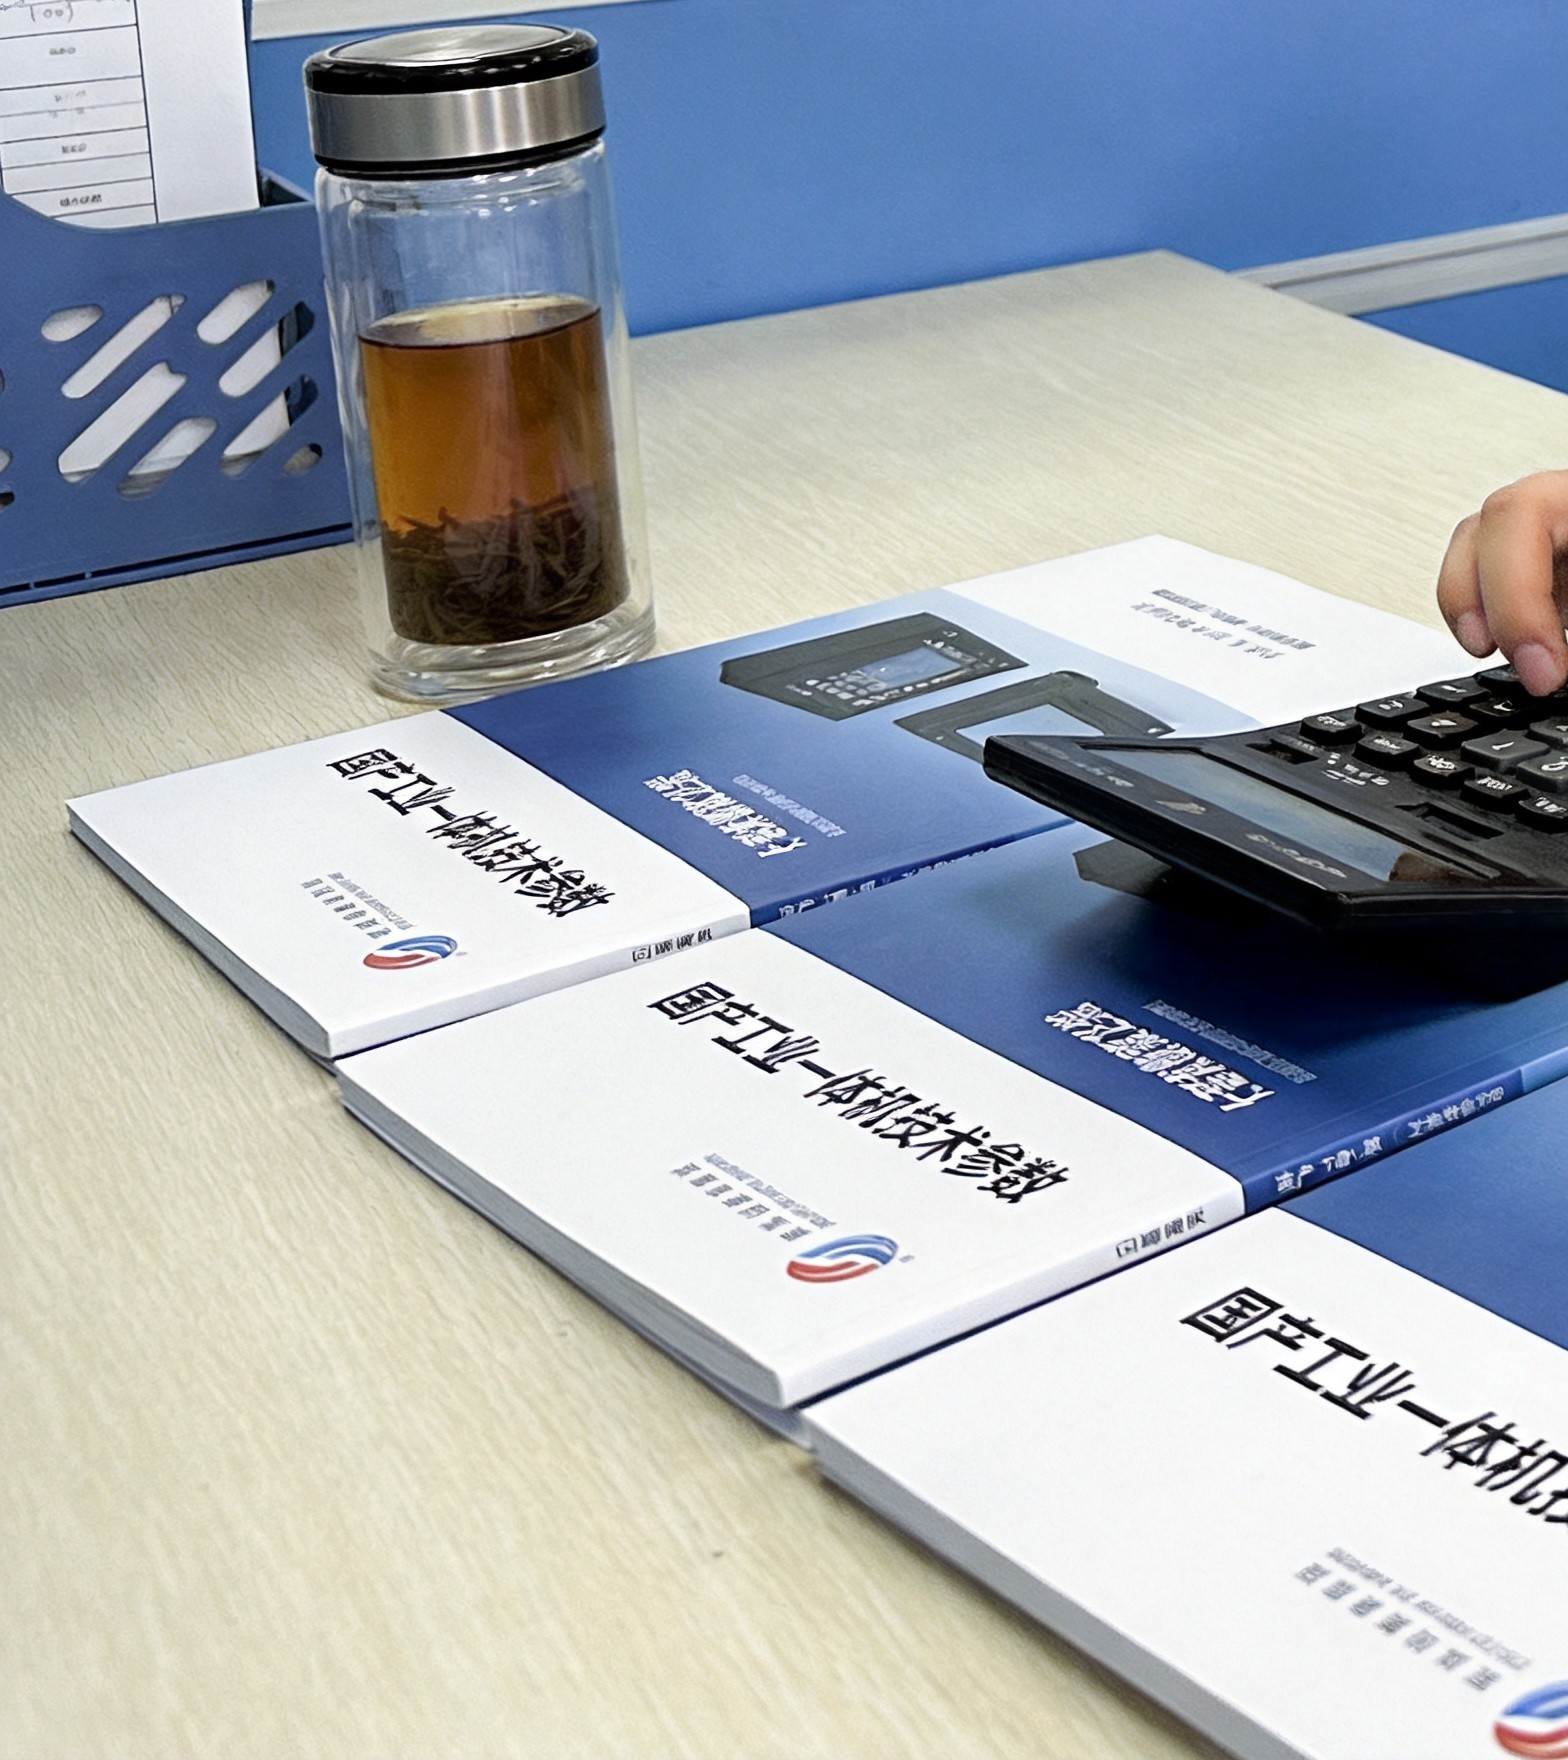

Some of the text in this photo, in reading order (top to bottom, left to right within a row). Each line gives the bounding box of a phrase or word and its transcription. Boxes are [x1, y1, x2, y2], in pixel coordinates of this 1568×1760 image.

[647, 981, 1069, 1204] 国产工业一体机技术参数
